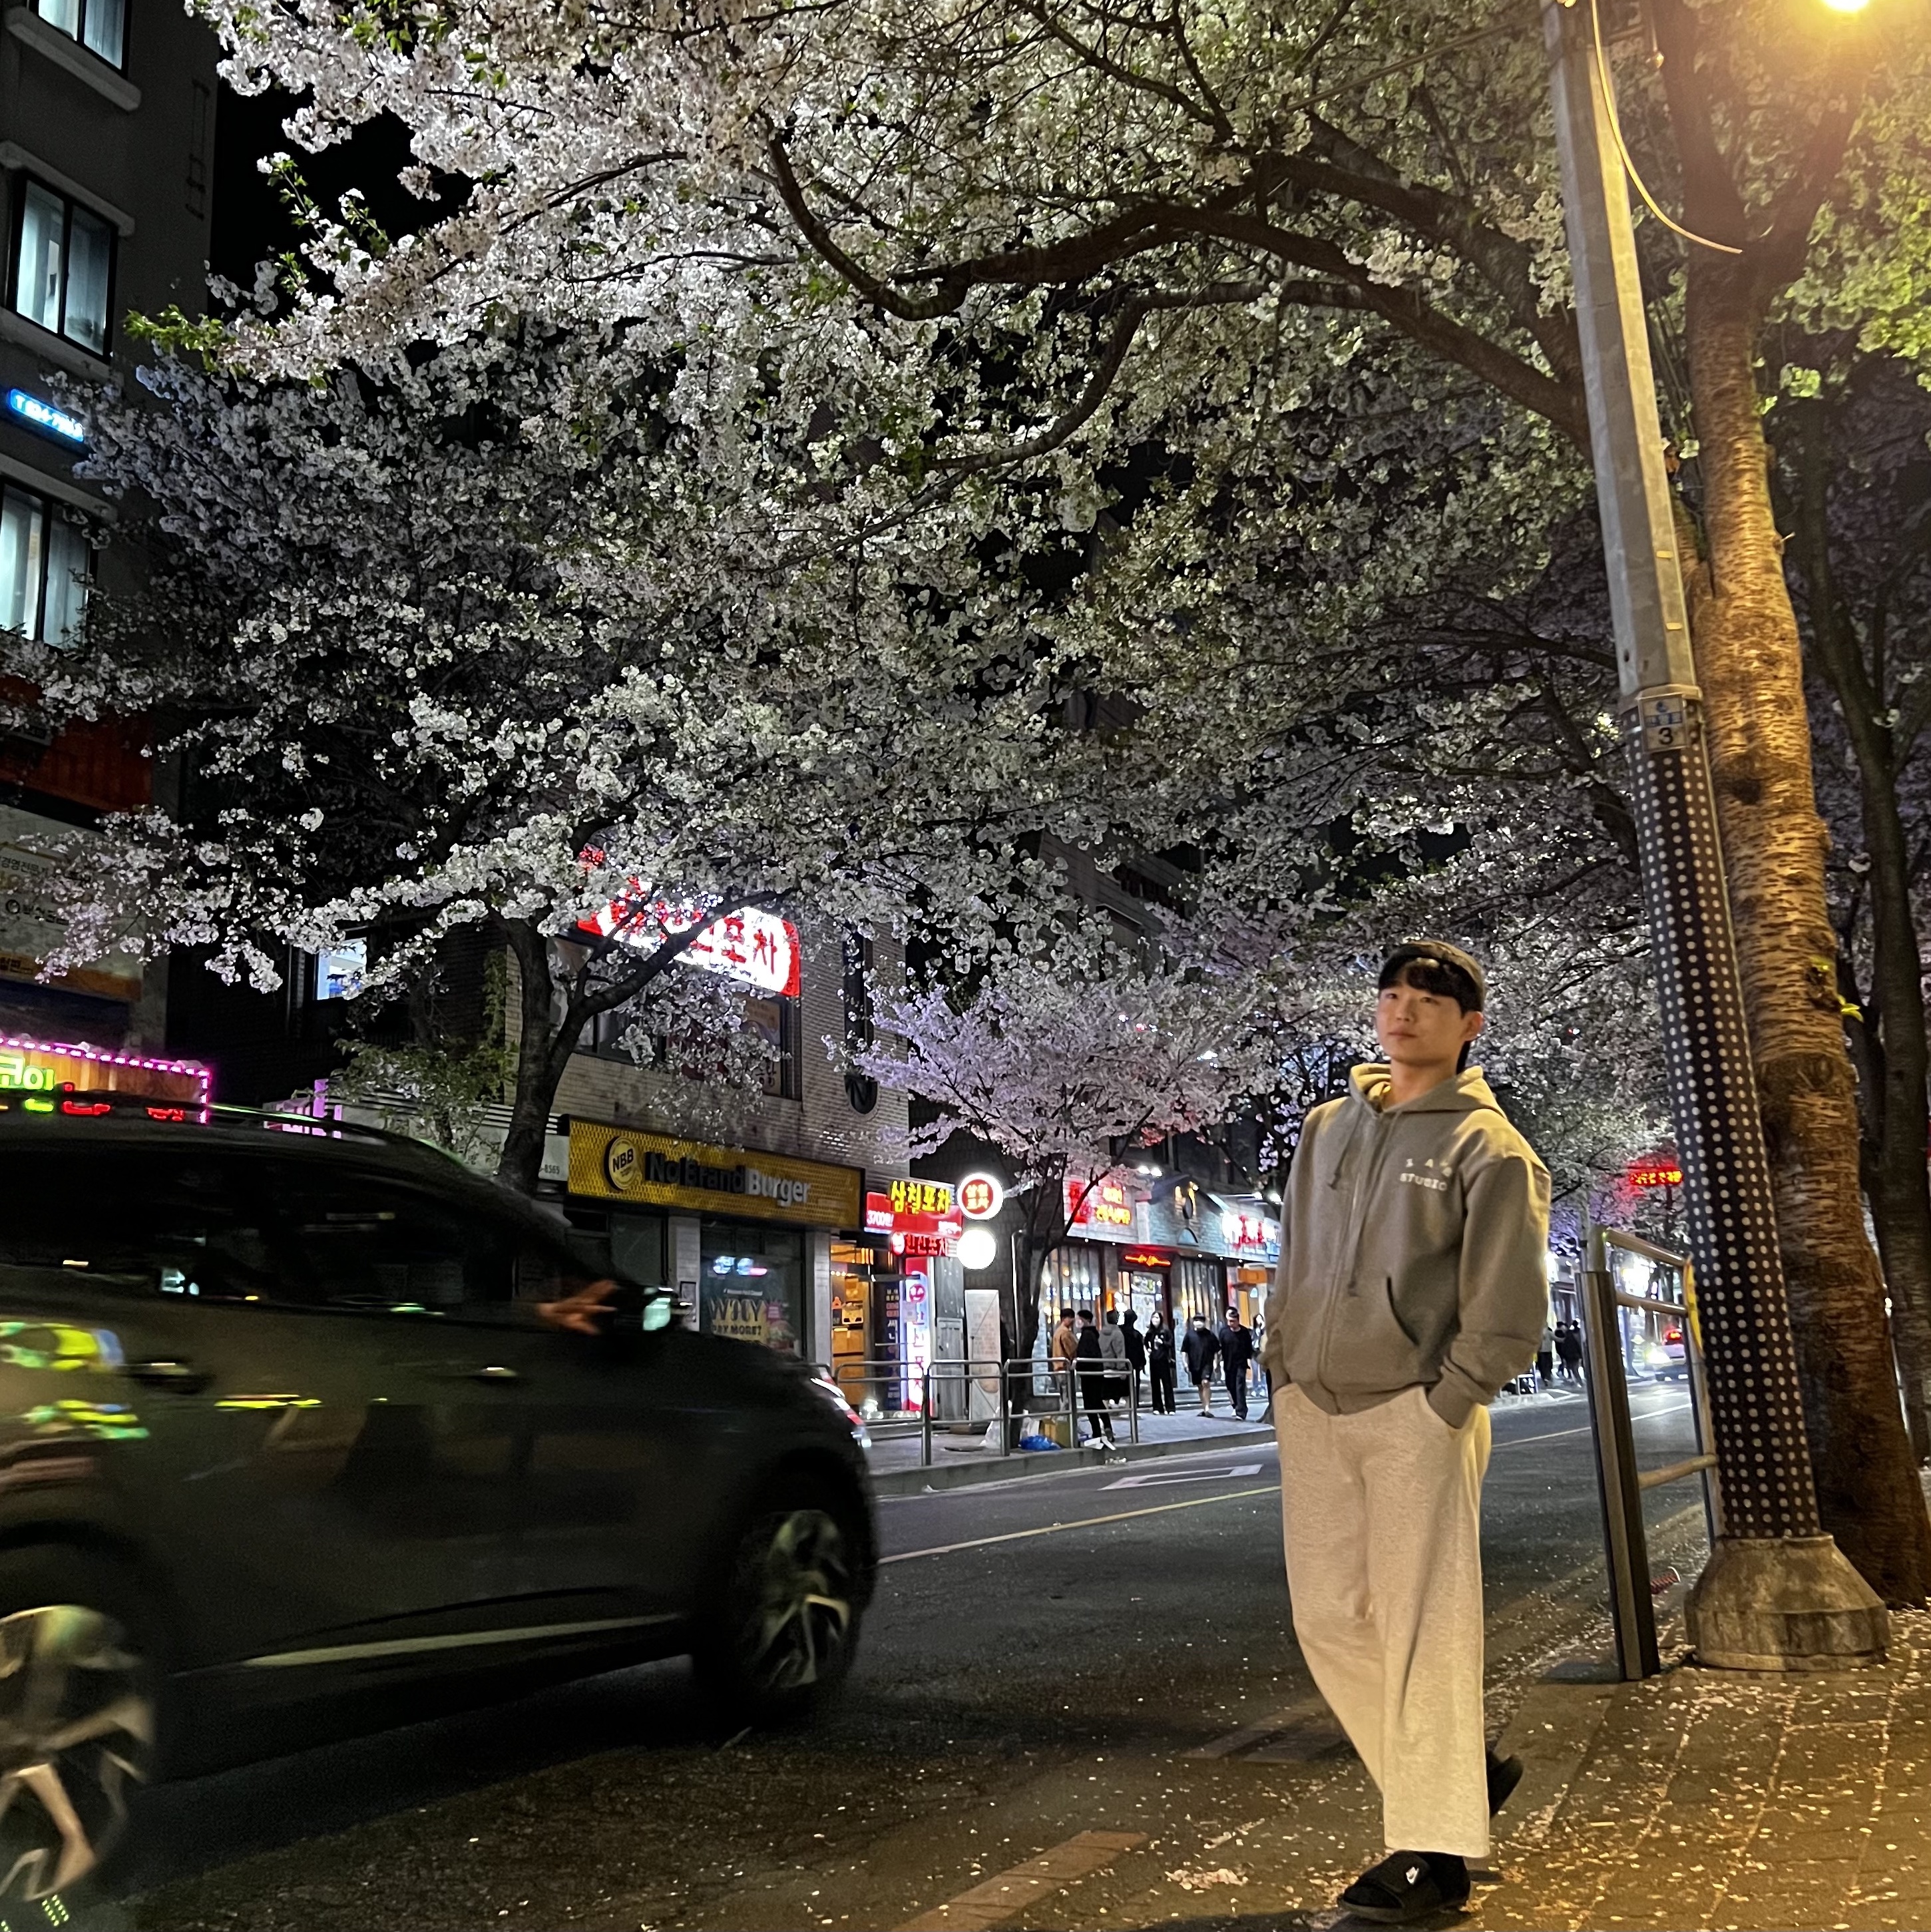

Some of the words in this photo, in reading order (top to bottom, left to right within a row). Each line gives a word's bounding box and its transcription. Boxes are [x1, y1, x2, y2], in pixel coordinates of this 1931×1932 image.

[1658, 727, 1673, 745] 3
[612, 1148, 634, 1173] NBB
[646, 1152, 680, 1184] No
[680, 1156, 746, 1194] Brand
[746, 1168, 810, 1207] Burger
